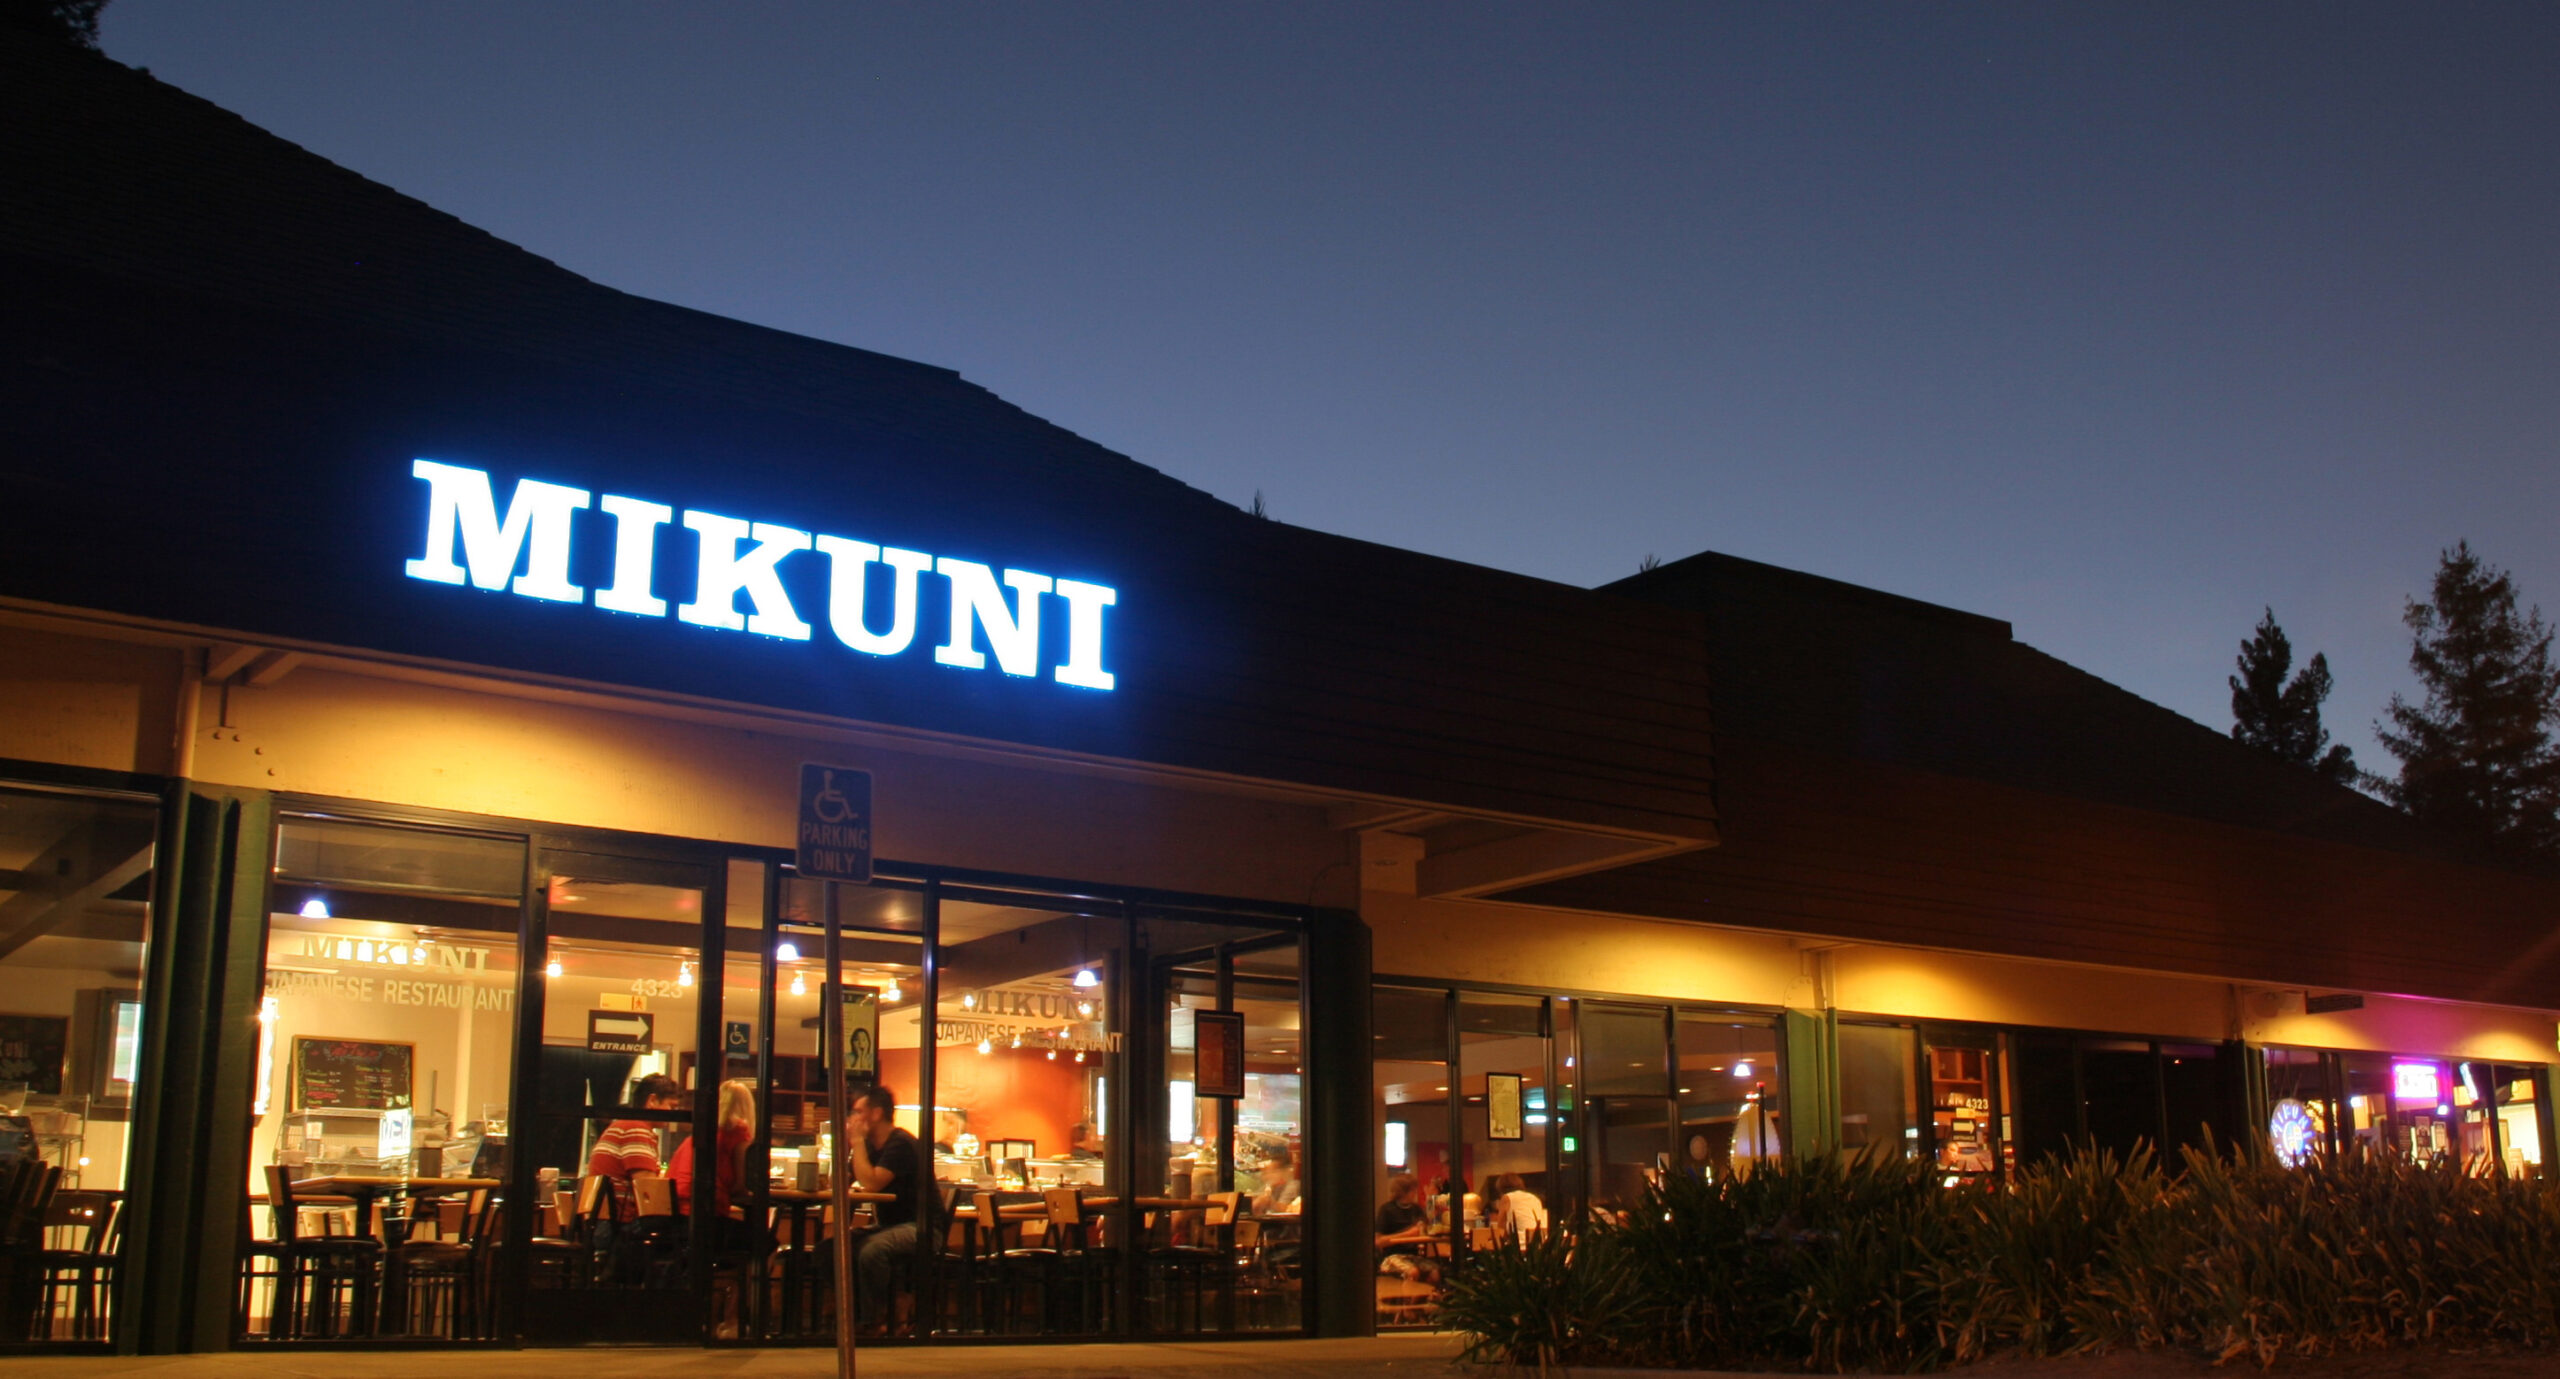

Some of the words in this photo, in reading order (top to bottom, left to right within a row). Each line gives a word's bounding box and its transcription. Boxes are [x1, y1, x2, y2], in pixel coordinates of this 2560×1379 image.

[405, 458, 1116, 690] MIKUNI
[801, 821, 868, 850] PARKING
[813, 849, 856, 873] ONLY
[302, 935, 491, 977] MIKUNI
[265, 970, 374, 1003] JAPANESE
[383, 980, 515, 1012] RESTAURANT
[630, 978, 684, 999] 4323
[959, 986, 1105, 1022] MIKUNI
[592, 1041, 649, 1053] ENTRANCE
[936, 1022, 1017, 1046] JAPANESE
[1965, 1098, 1989, 1110] 4323
